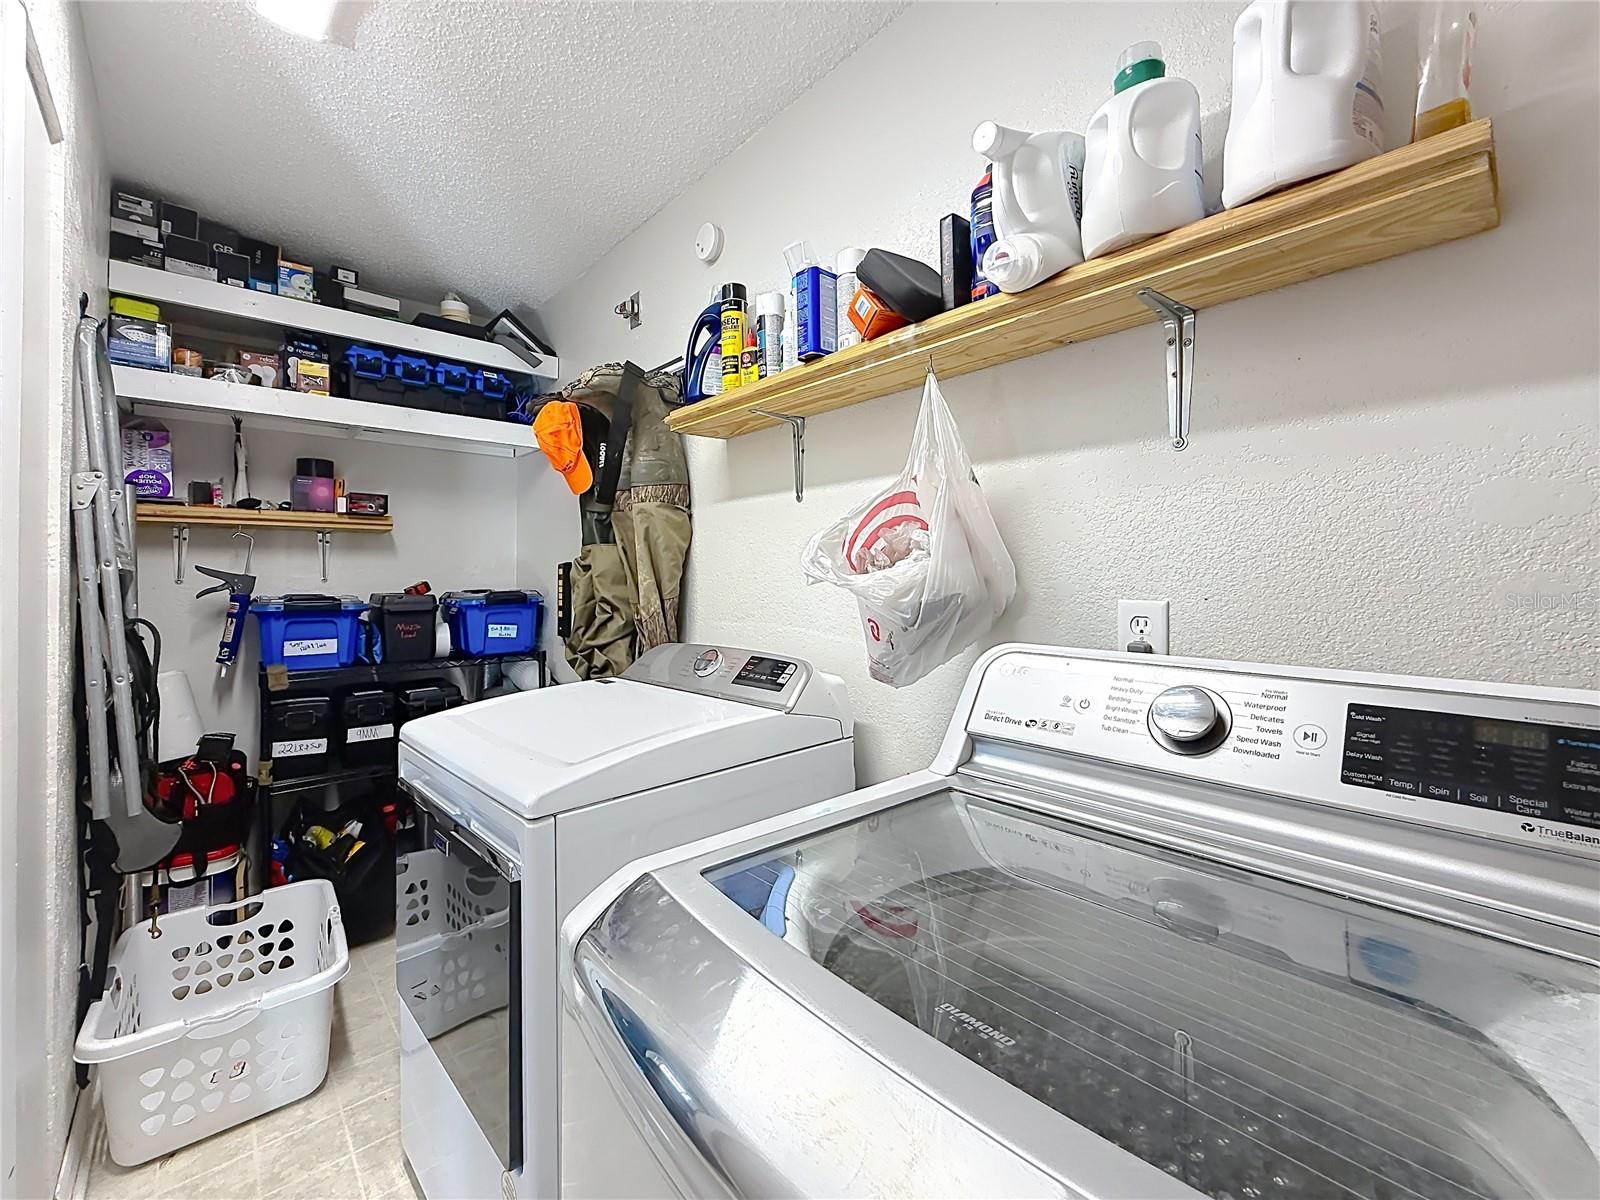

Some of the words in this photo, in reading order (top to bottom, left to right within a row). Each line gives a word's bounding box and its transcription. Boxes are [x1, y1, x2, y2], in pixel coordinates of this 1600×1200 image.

[1113, 675, 1134, 683] Normal
[1129, 687, 1144, 695] Duty
[1260, 692, 1288, 701] Normal
[1108, 694, 1132, 704] Bedding
[1243, 701, 1287, 712] Waterproof
[984, 712, 1004, 723] Direct
[1004, 715, 1023, 726] Drive
[1250, 713, 1285, 724] Delicates
[1112, 726, 1129, 734] Clean
[1255, 725, 1283, 736] Towels
[1355, 731, 1376, 739] Signal
[1236, 734, 1259, 745] Speed
[1260, 738, 1282, 748] Wash
[1232, 746, 1281, 760] Downloaded
[1345, 750, 1364, 760] Delay
[1364, 753, 1383, 761] Wash
[1570, 760, 1598, 770] Fabric
[1342, 769, 1367, 779] Custom
[1367, 773, 1383, 782] PGM
[1562, 781, 1586, 791] Extra
[1388, 778, 1416, 791] Temp.
[1428, 785, 1450, 797] Spin
[1469, 792, 1488, 803] Soil
[1508, 794, 1548, 809] Special
[1516, 804, 1542, 816] Care
[1563, 807, 1592, 818] Water
[939, 1003, 1017, 1046] DIAMOND
